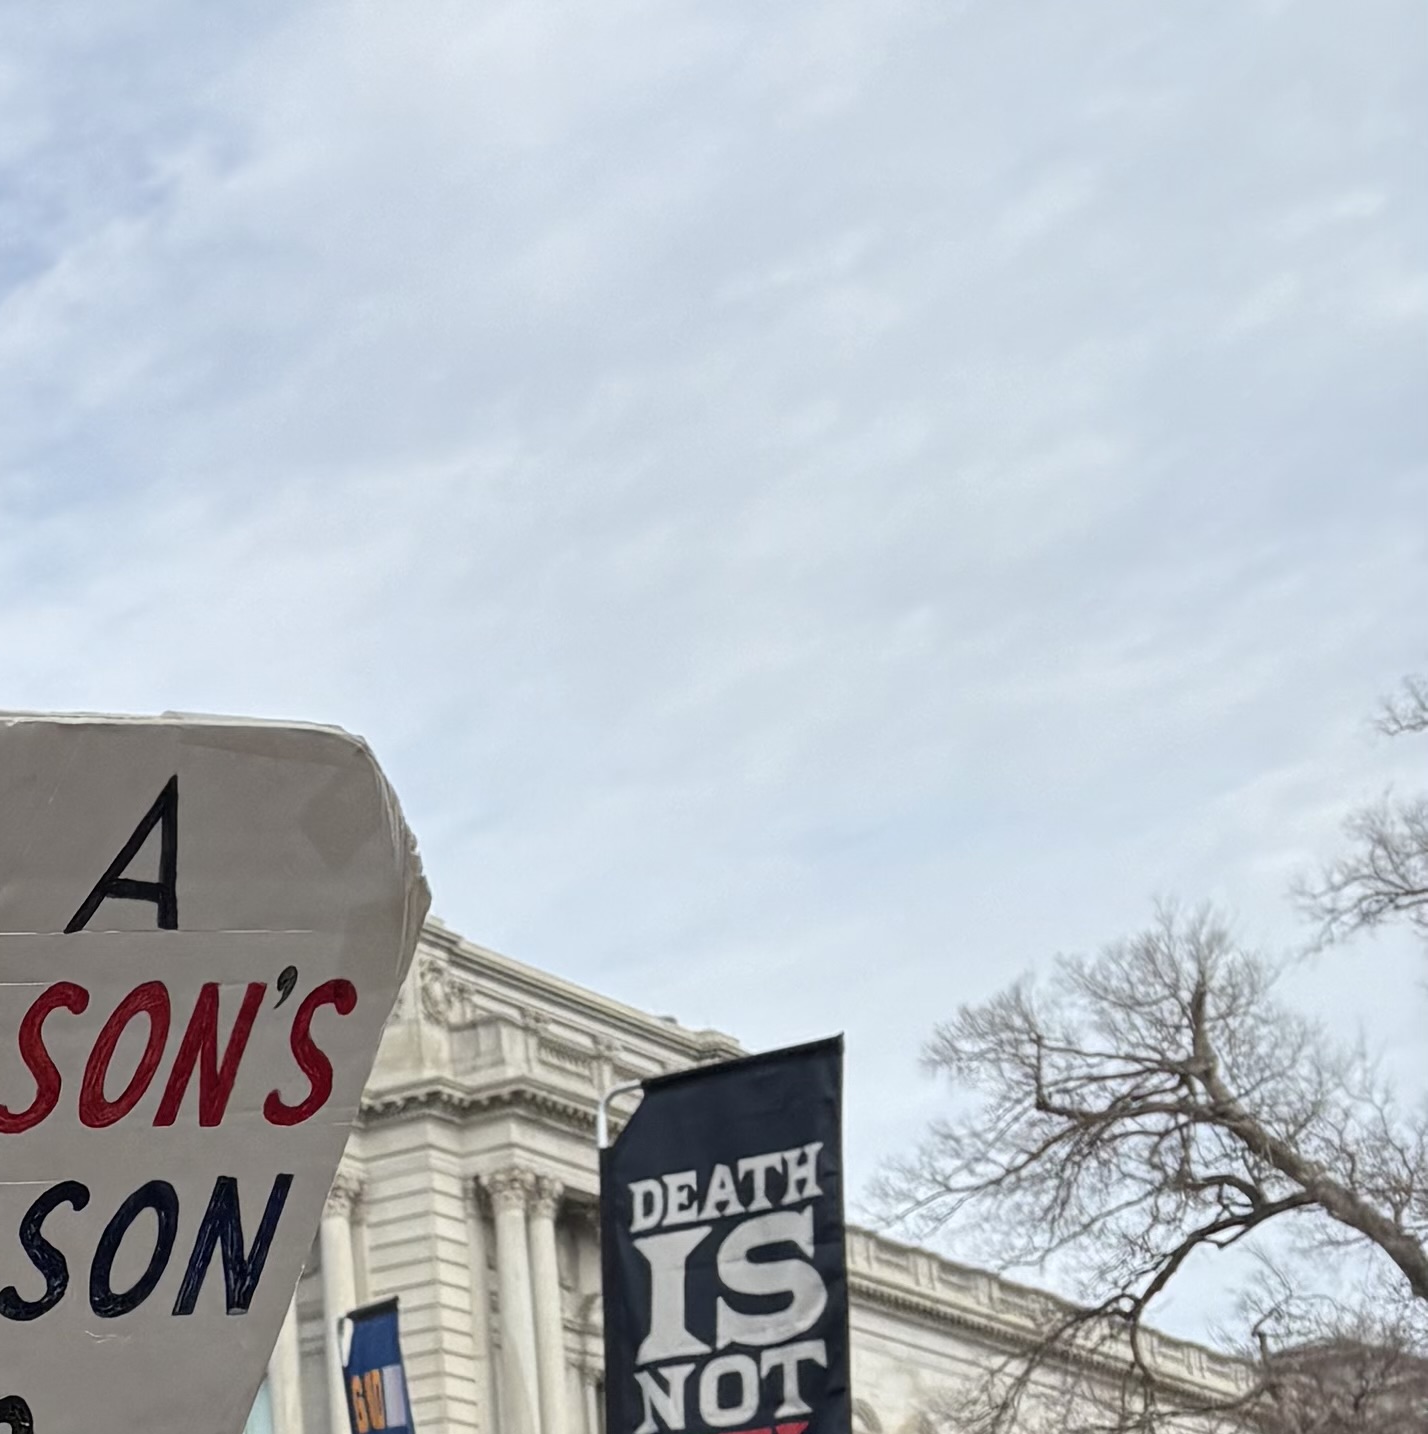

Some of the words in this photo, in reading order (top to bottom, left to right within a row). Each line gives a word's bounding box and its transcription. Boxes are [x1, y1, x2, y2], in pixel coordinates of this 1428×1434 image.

[64, 774, 178, 933] A
[628, 1142, 824, 1233] DEATH
[633, 1205, 828, 1366] IS
